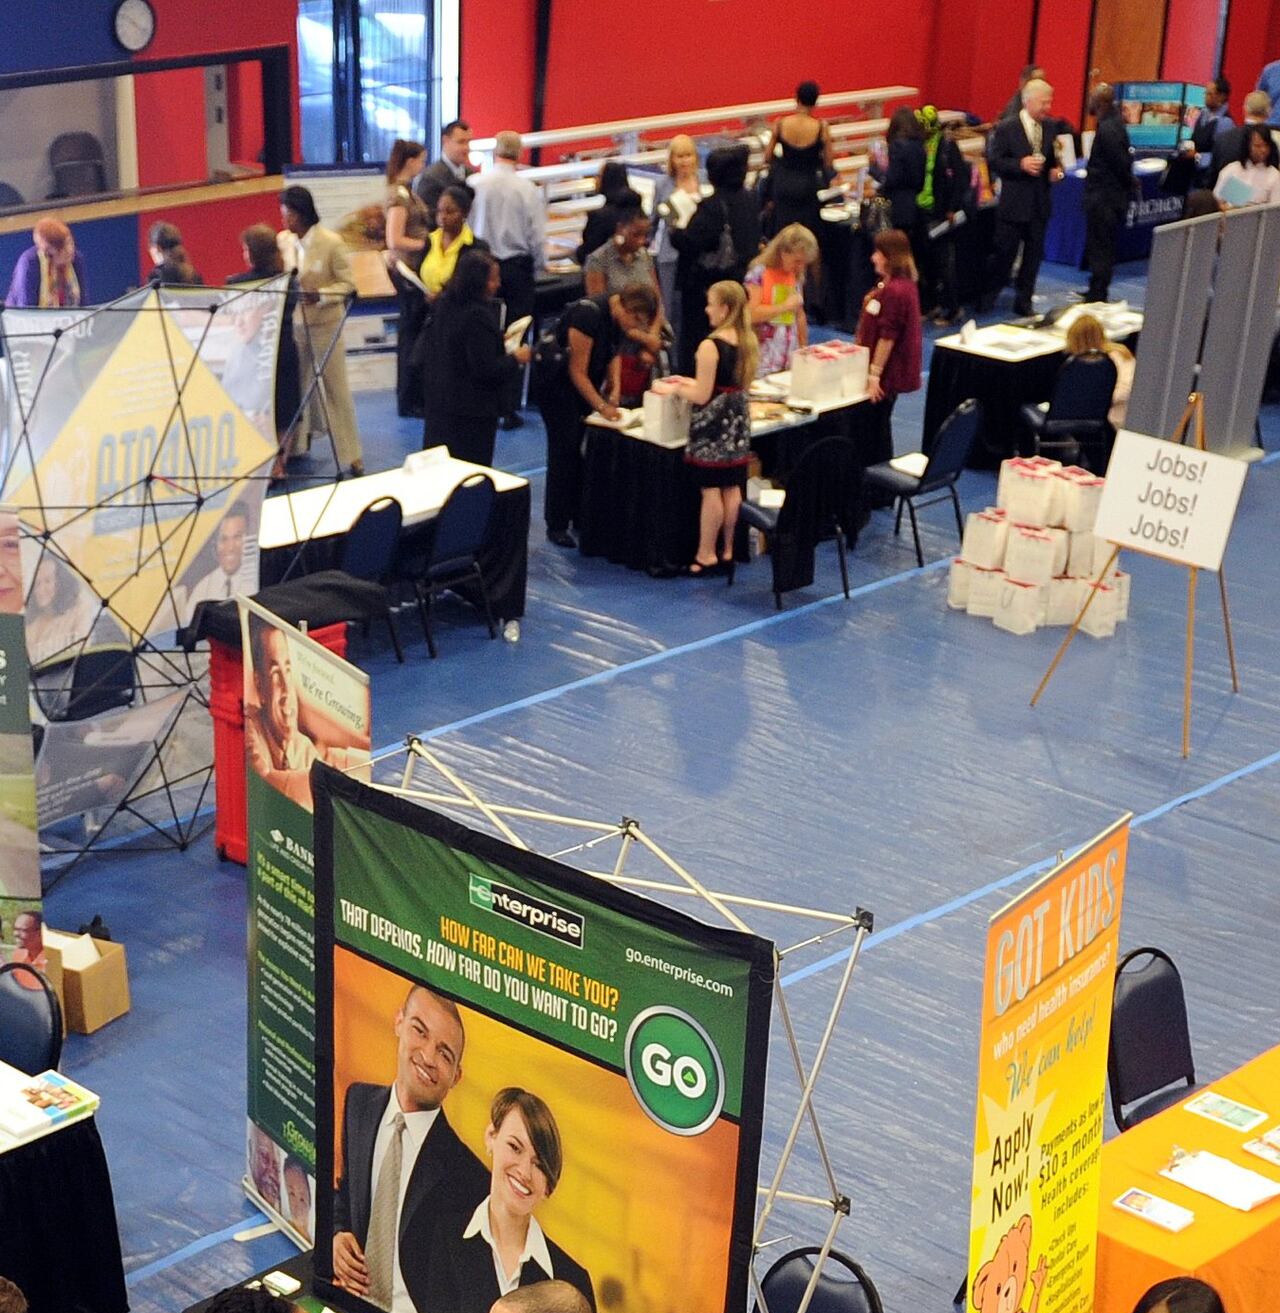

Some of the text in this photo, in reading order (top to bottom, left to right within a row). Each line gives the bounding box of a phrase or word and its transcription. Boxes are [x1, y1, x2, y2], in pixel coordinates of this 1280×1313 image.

[1146, 448, 1207, 484] Jobs!
[1137, 481, 1198, 517] Jobs!
[1129, 514, 1189, 550] Jobs!
[285, 836, 315, 867] BANK
[471, 882, 582, 940] enterprise
[994, 847, 1119, 1017] GOT KIDS
[339, 898, 368, 933] THAT
[370, 913, 424, 960] DEPENDS.
[426, 938, 457, 972] HOW
[458, 953, 481, 985] FAR
[483, 965, 501, 993] DO
[503, 973, 529, 1006] YOU
[531, 984, 570, 1021] WANT
[571, 1002, 588, 1032] TO
[590, 1011, 618, 1043] GO?
[439, 915, 619, 1012] HOW FAR CAN WE TAKE YOU?
[625, 947, 734, 998] go.enterprise.com
[993, 942, 1111, 1061] who need health insurance?
[641, 1043, 707, 1099] GO
[1006, 998, 1097, 1103] We can help!
[990, 1111, 1034, 1177] Apply
[1040, 1119, 1077, 1161] Payments
[991, 1155, 1030, 1224] Now!
[1038, 1153, 1060, 1189] $10
[1061, 1150, 1068, 1168] a
[1041, 1147, 1100, 1211] Health coverag
[1053, 1182, 1089, 1222] includes:
